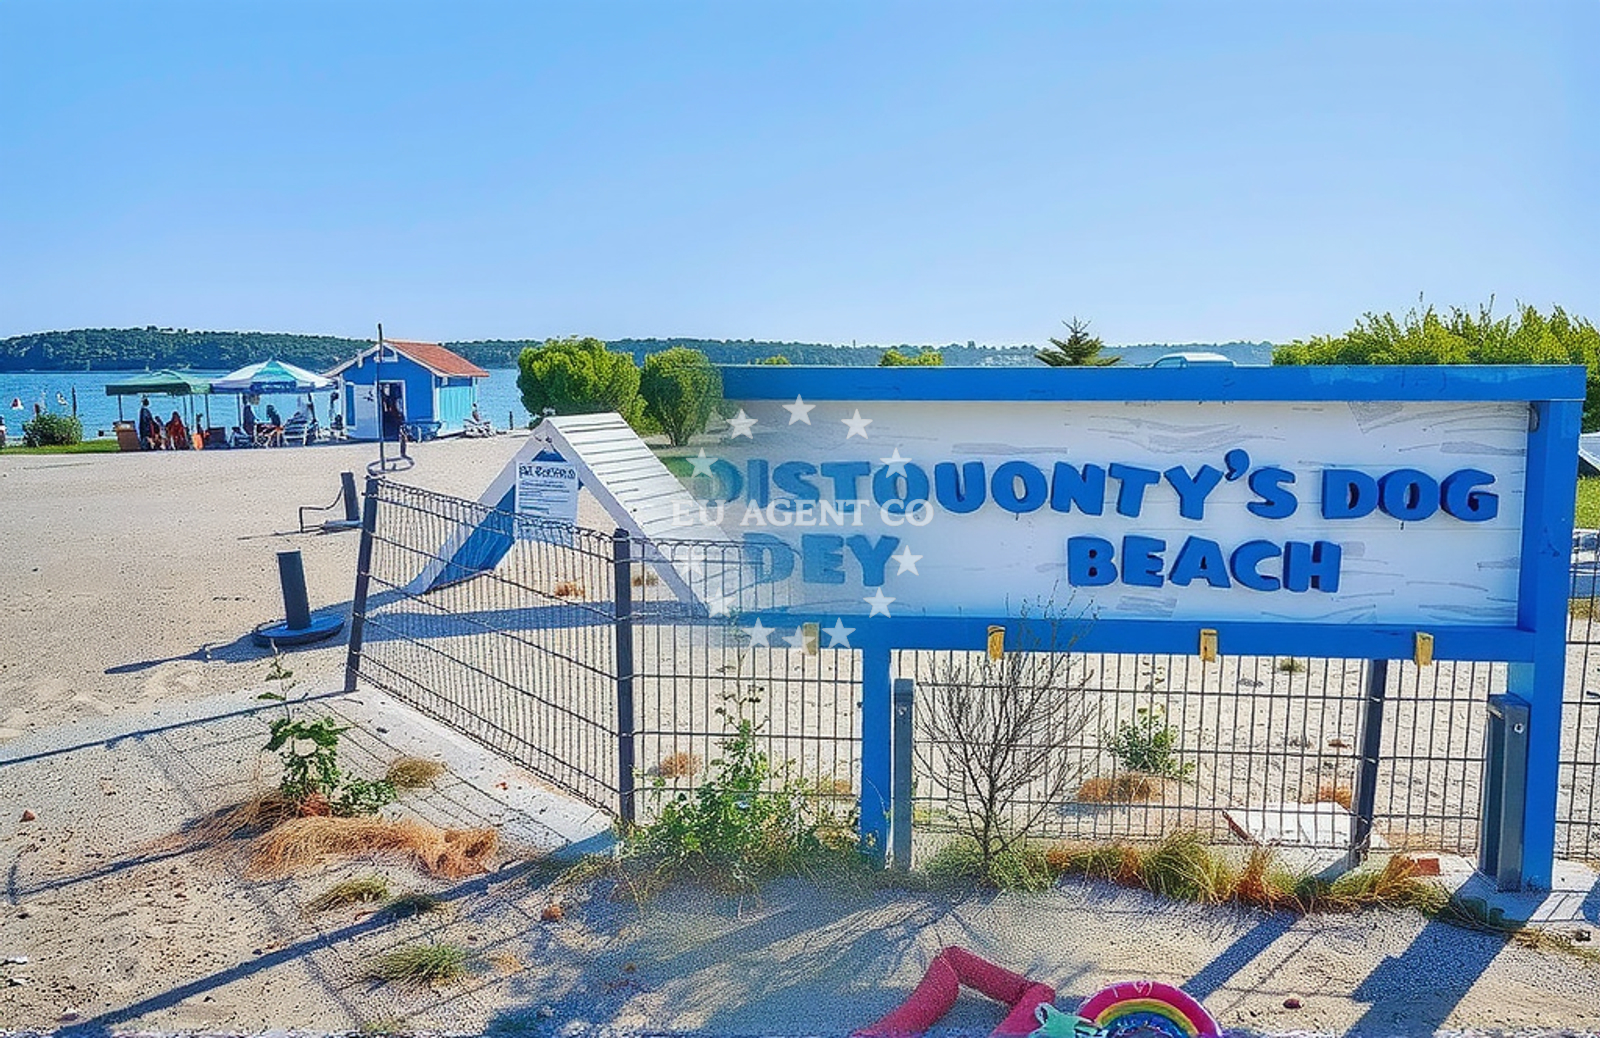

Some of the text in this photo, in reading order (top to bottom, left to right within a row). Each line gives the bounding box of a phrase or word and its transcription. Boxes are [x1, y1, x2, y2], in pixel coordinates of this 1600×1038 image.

[1320, 467, 1500, 523] DOG
[741, 531, 1343, 594] DEY BEACH
